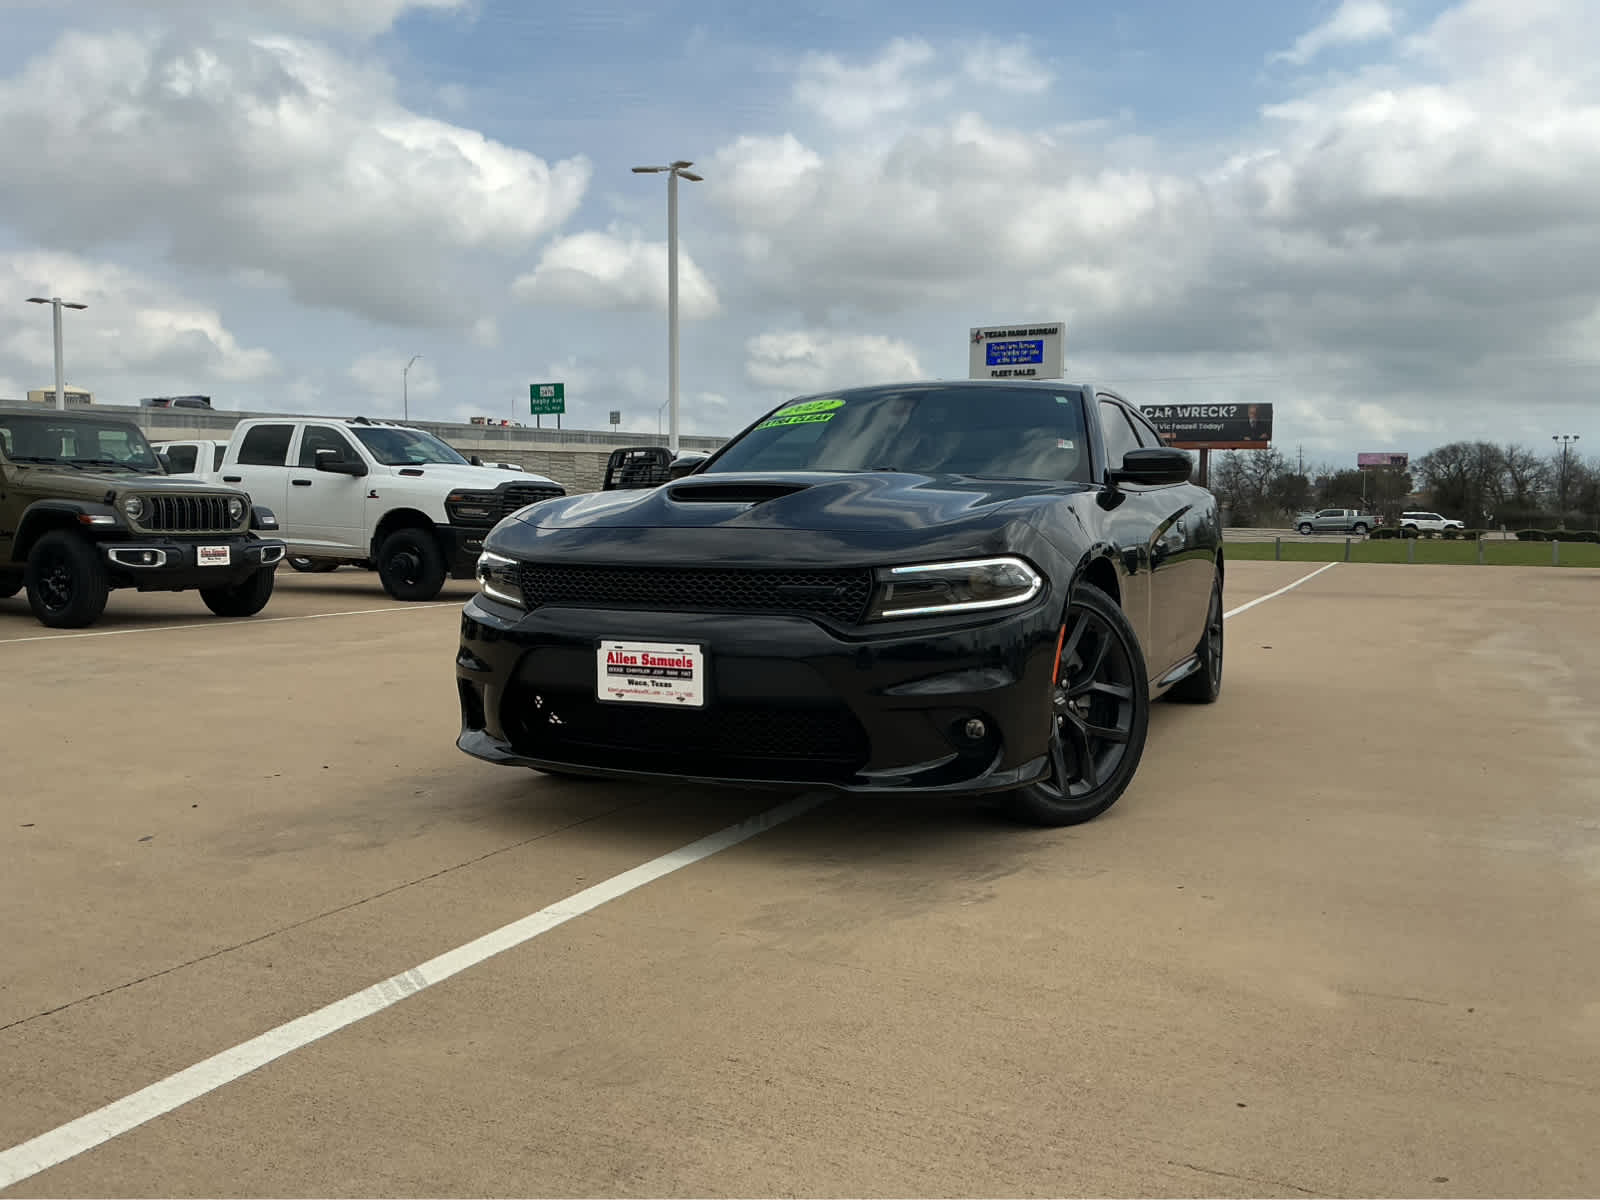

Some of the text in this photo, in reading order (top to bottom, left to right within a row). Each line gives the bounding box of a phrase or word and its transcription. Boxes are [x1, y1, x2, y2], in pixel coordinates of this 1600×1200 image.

[1029, 328, 1057, 336] BUREAU
[991, 368, 1036, 377] FLEET SALES
[1143, 405, 1238, 418] CAR WRECK?
[1199, 422, 1225, 433] Today!
[607, 651, 693, 668] Allen Samuels
[627, 679, 673, 689] Waco, Texas
